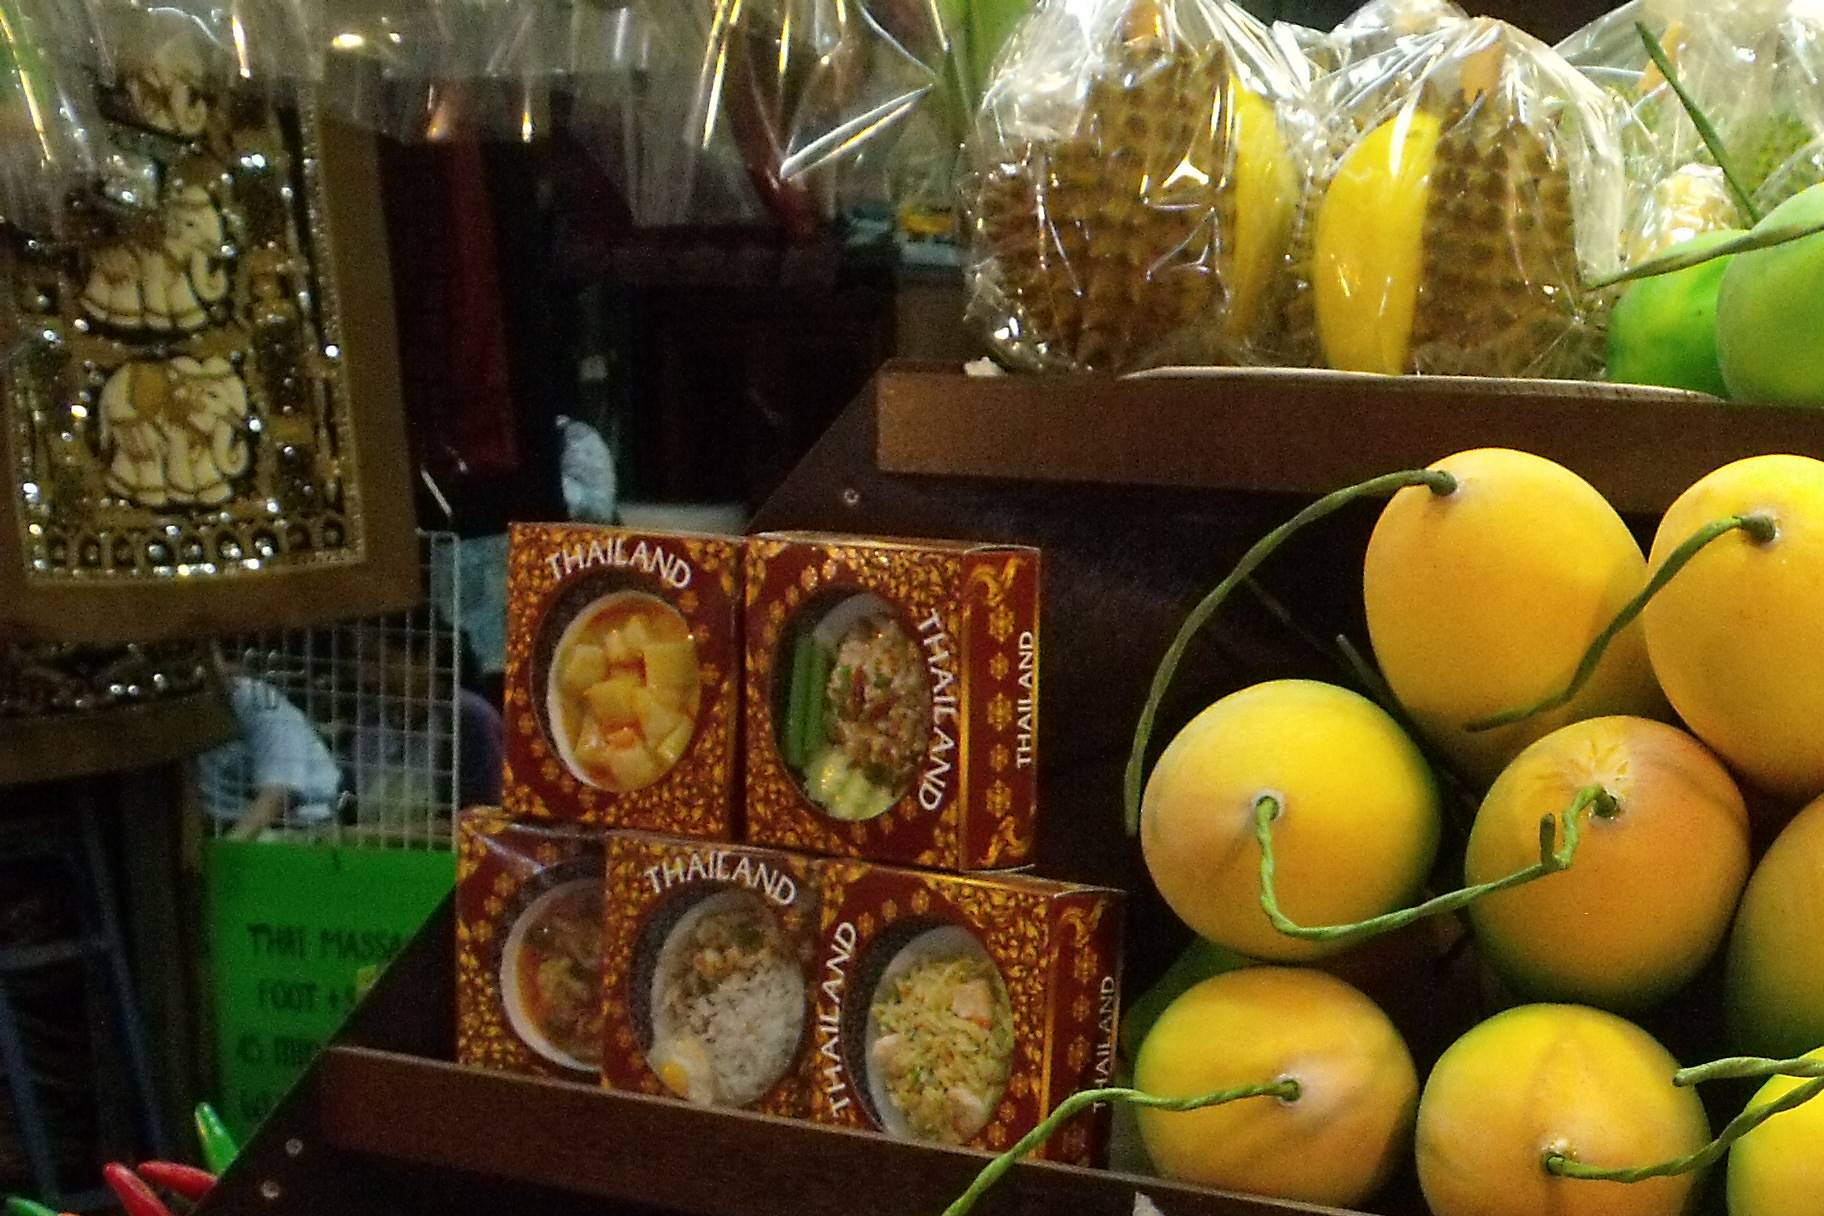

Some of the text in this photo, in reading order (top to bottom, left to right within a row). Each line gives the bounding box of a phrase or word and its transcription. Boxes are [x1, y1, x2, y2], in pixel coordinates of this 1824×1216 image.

[545, 538, 692, 590] THAILAND
[918, 608, 957, 812] THAILAND
[1016, 631, 1033, 768] THAILAND
[644, 850, 797, 906] THAILAND
[819, 922, 857, 1118] THAILAND
